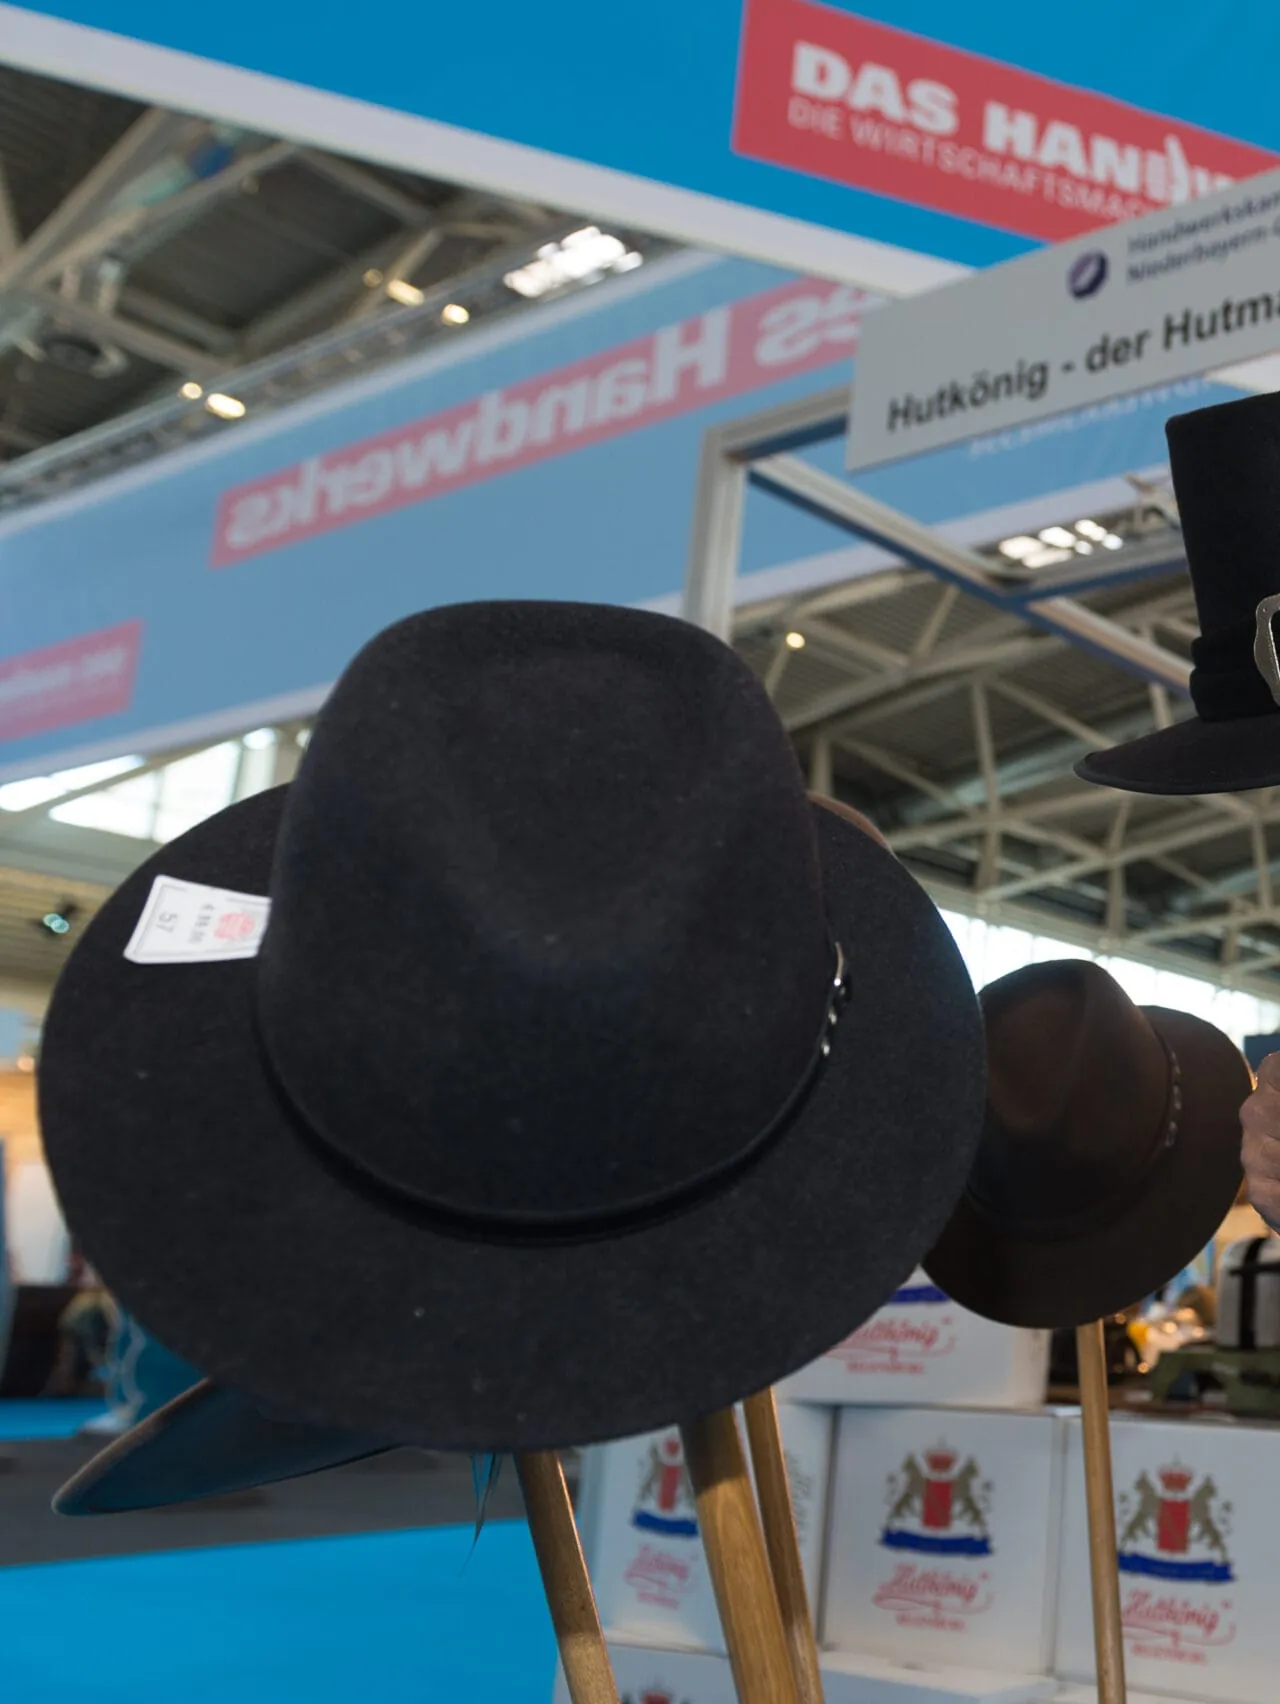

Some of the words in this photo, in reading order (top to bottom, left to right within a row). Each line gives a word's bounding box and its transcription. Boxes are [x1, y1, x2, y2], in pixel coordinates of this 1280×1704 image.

[786, 95, 845, 141] DIE
[790, 39, 959, 136] DAS
[886, 357, 1051, 433] Hutkönig
[1085, 328, 1152, 375] der
